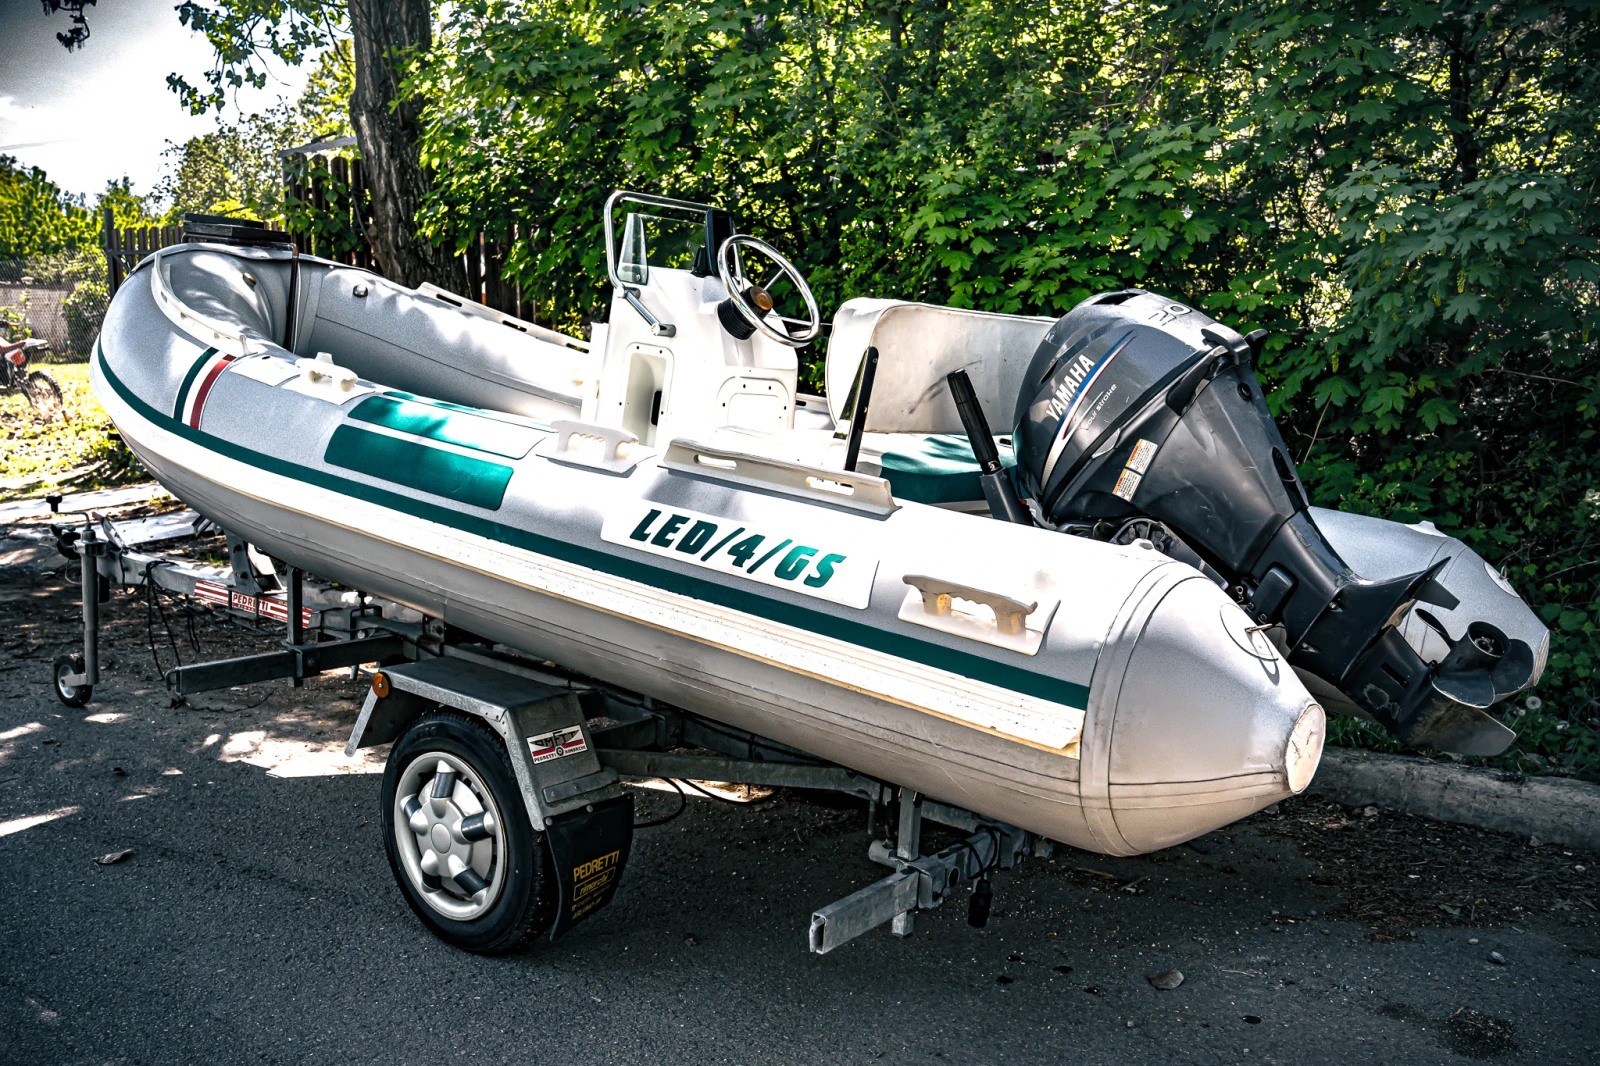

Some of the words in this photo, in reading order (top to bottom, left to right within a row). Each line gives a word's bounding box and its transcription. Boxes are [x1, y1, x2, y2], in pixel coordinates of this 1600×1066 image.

[1046, 354, 1095, 421] YAMAHA
[629, 509, 847, 588] LED/4/GS
[233, 594, 268, 611] PEDRTI
[573, 850, 620, 882] PEDRETTI
